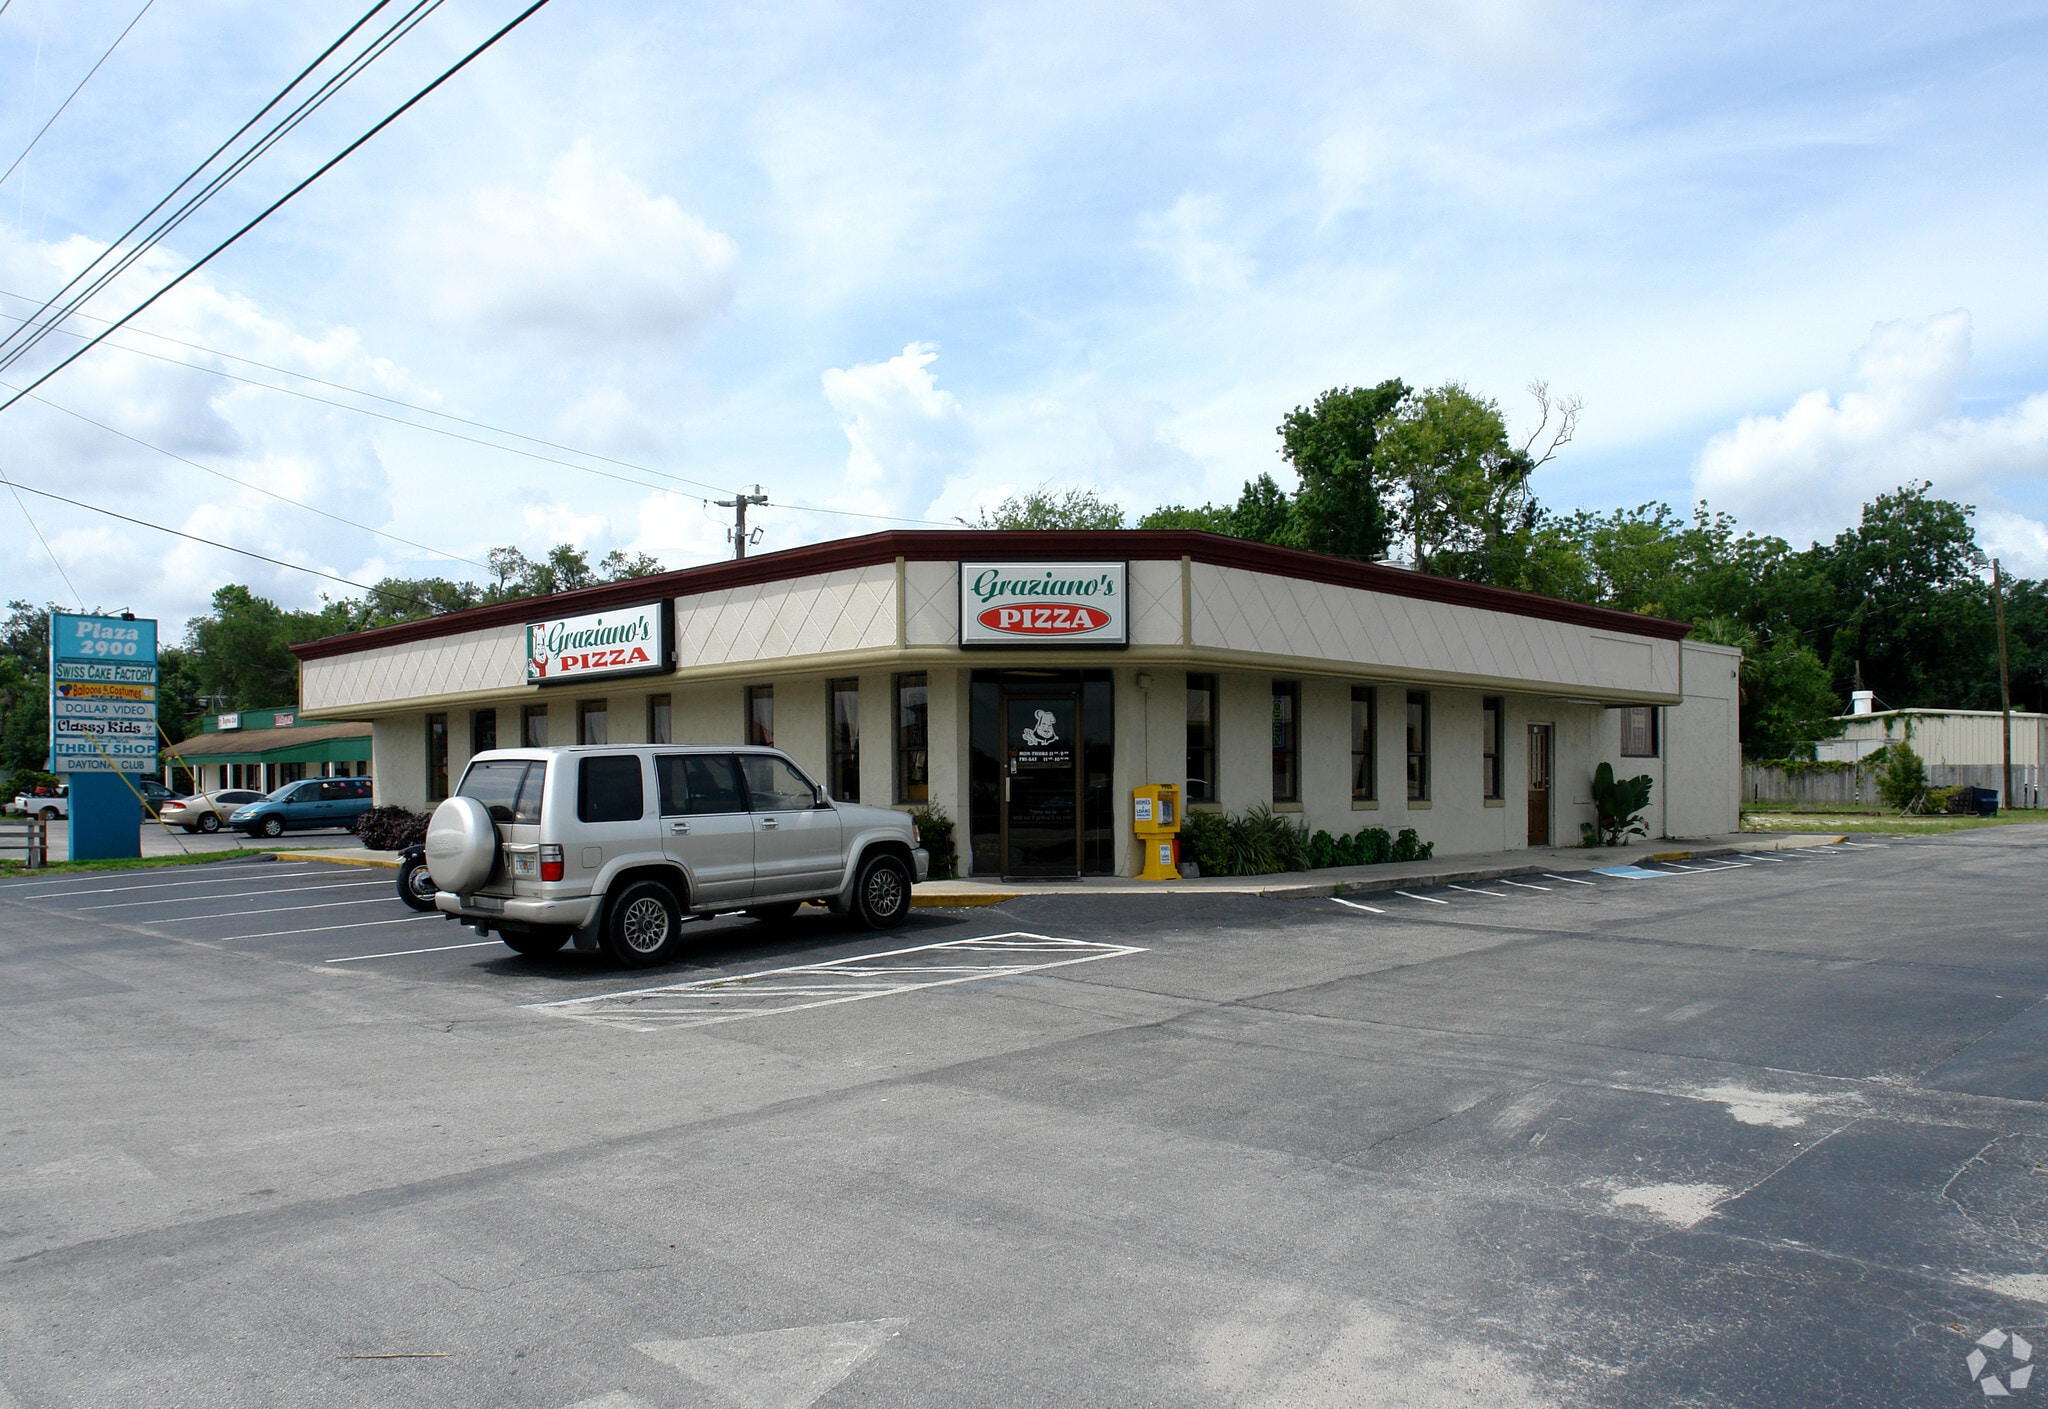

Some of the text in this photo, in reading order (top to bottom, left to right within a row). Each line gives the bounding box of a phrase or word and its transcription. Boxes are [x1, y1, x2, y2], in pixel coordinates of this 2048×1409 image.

[971, 569, 1117, 603] Graziano's
[999, 609, 1094, 629] PIZZA
[76, 621, 139, 641] Plaza
[546, 616, 651, 660] Graziano's
[80, 640, 137, 656] 2900
[560, 647, 650, 671] PIZZA
[88, 665, 111, 680] CAKE
[115, 667, 154, 682] FACTORY
[73, 684, 102, 697] Balloons
[109, 685, 142, 700] Costumes
[66, 703, 146, 715] DOLLAR VIDEO
[57, 719, 106, 735] Classy
[108, 720, 141, 734] Kids
[113, 744, 156, 755] SHOP
[121, 761, 145, 771] CLUB
